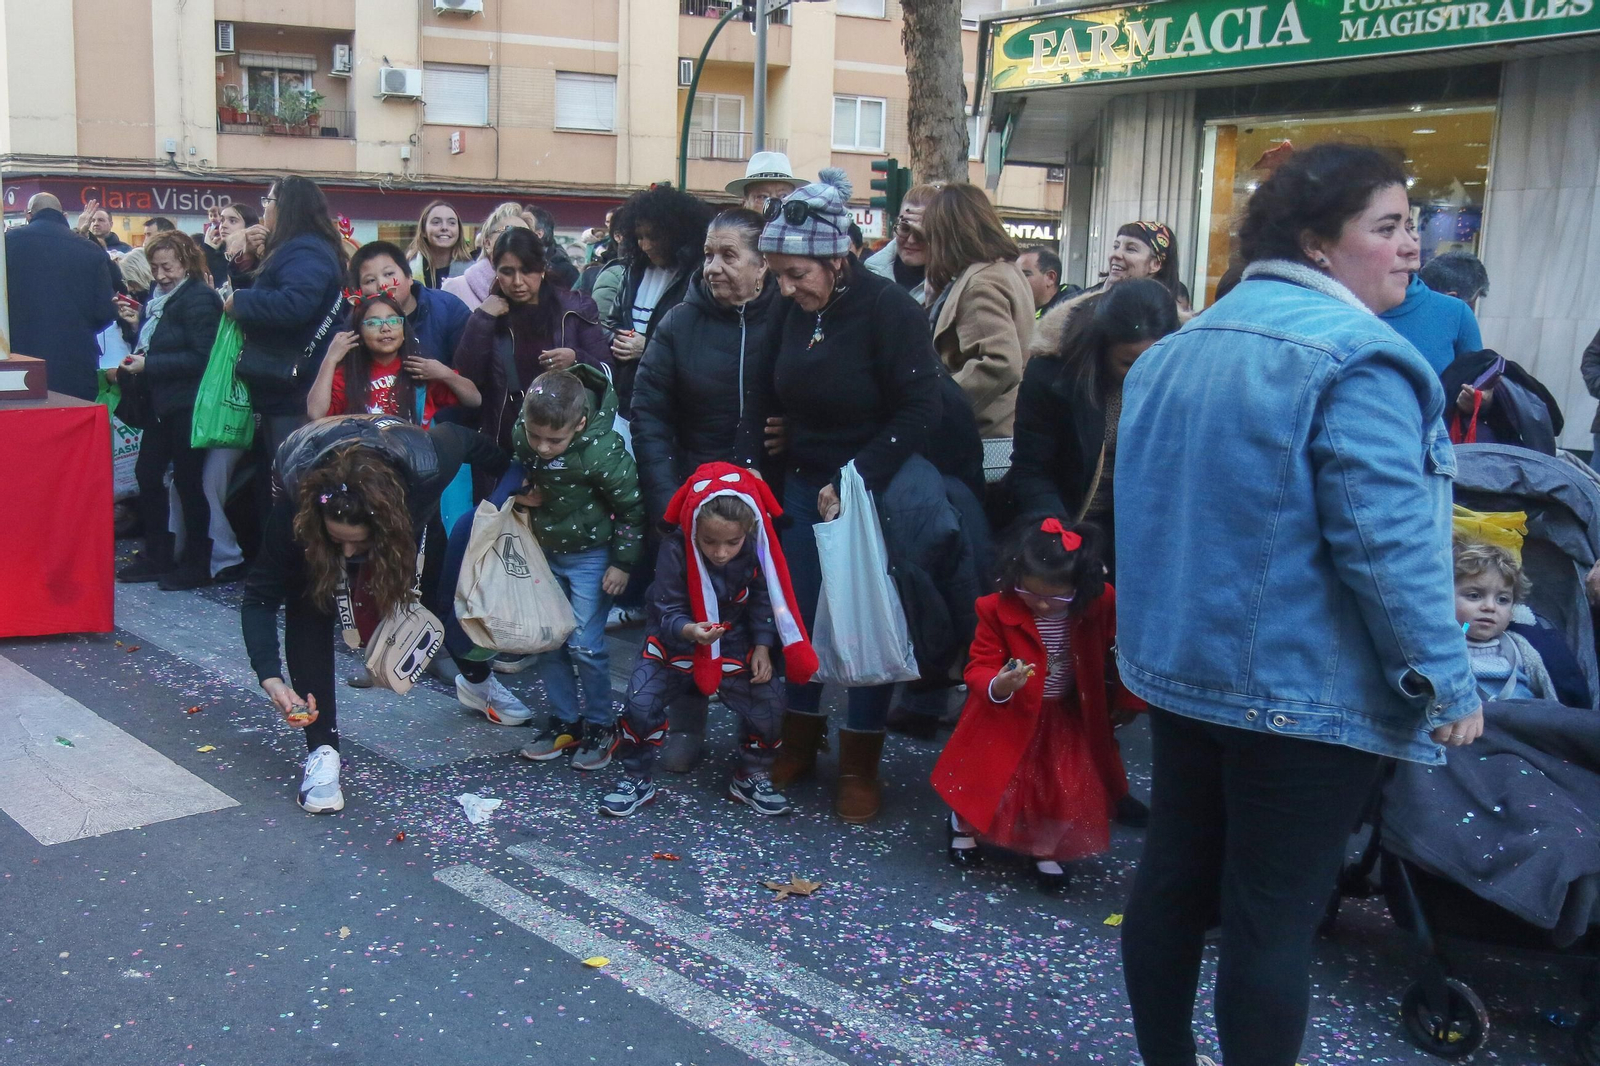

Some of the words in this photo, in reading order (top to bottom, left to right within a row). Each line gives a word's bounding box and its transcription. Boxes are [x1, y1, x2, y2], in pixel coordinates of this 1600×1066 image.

[1027, 0, 1311, 73] FARMACIA
[1338, 0, 1594, 42] MAGISTRALES
[1003, 223, 1054, 240] ENTAL
